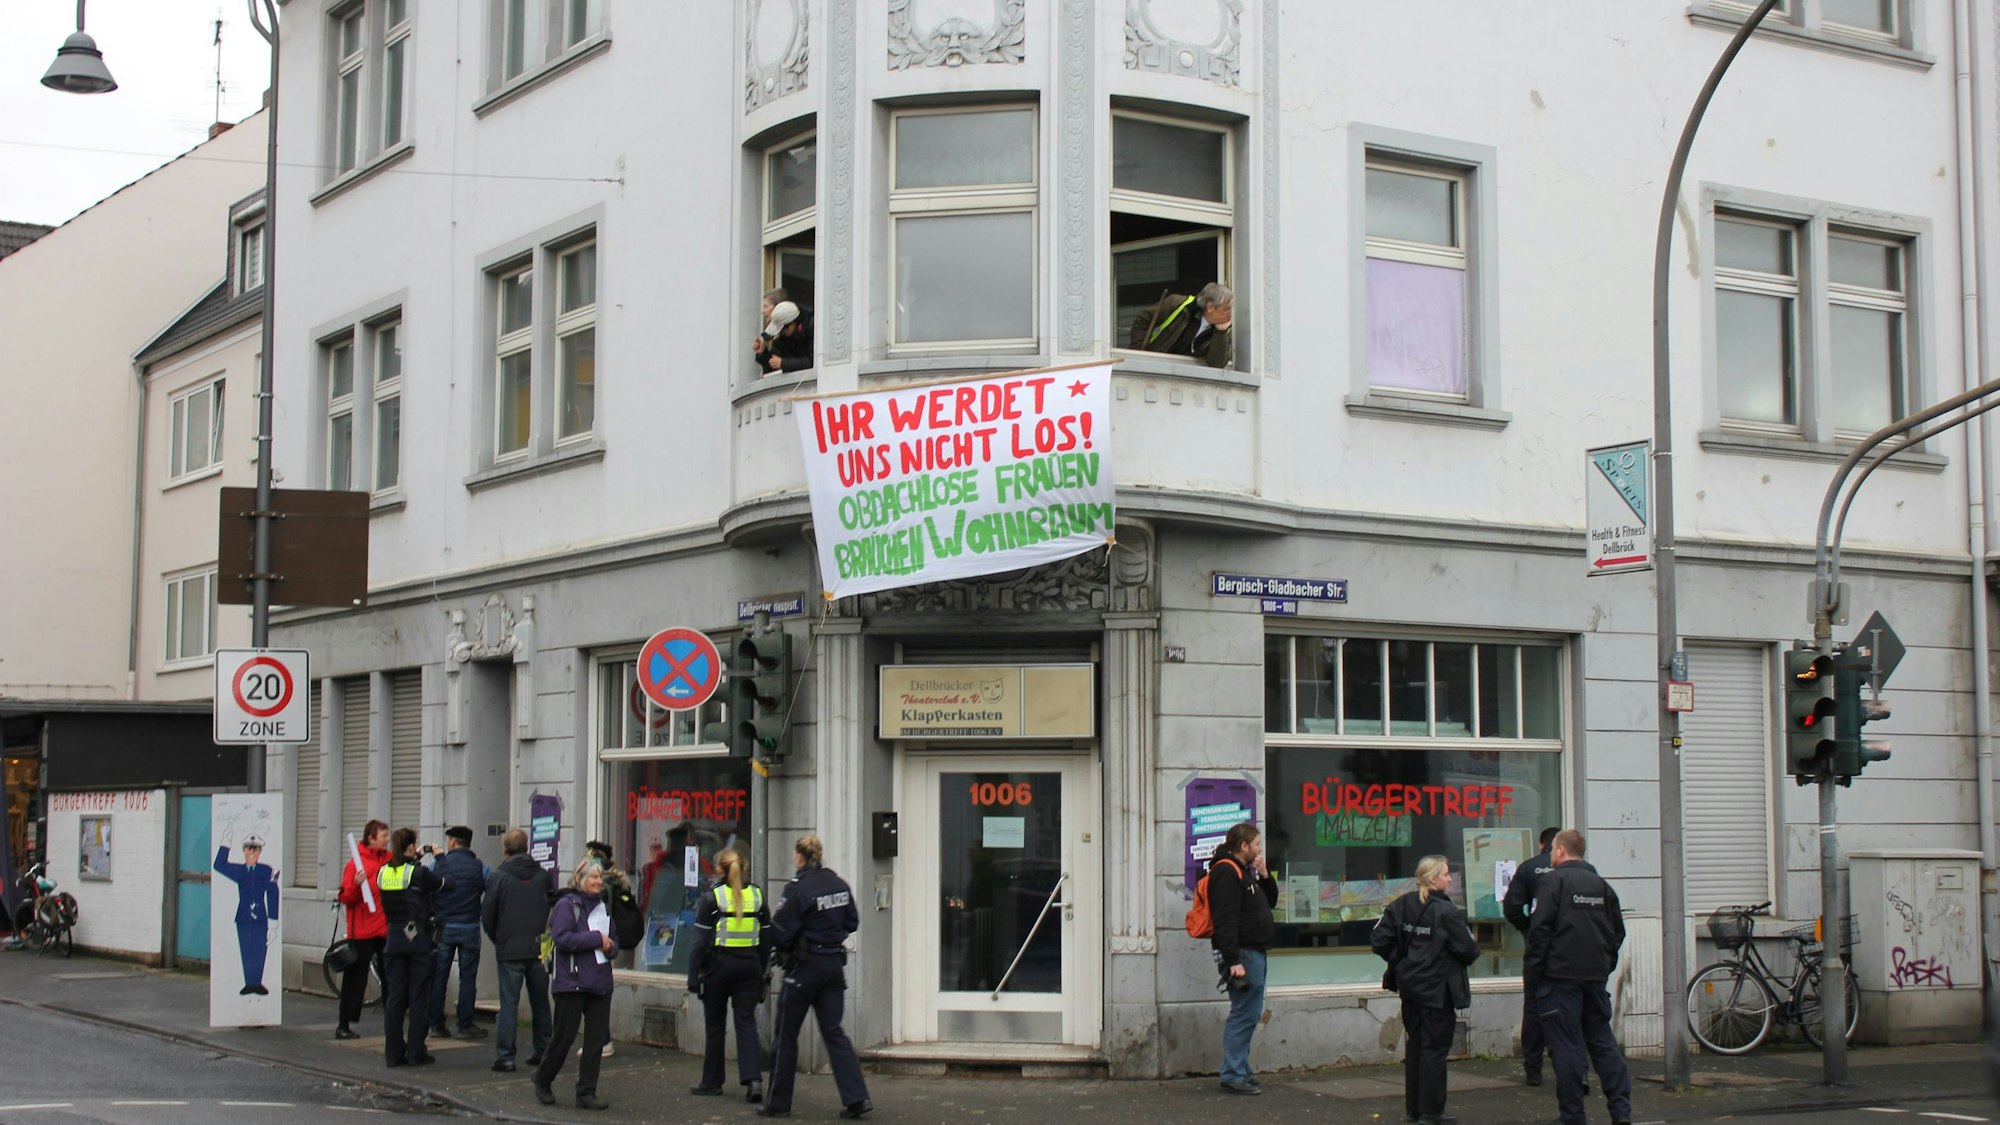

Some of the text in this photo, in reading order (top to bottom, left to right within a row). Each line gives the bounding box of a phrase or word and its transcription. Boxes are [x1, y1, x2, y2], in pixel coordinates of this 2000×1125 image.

[812, 378, 1055, 453] IHR WERDET
[837, 411, 1092, 488] UNS NICHT LOS!
[838, 469, 979, 530] OBDACHLOSE
[924, 502, 1113, 559] WOHNRAUM
[1592, 525, 1646, 541] Health & Fitness
[1602, 541, 1635, 554] Dellbrück
[1218, 576, 1345, 598] Bergisch-Gladbacher Str.
[246, 674, 281, 700] 20
[911, 680, 974, 691] Dellbrücker
[901, 693, 960, 705] Theaterclub
[901, 709, 1003, 725] Klapperkasten
[239, 721, 286, 736] ZONE
[124, 790, 148, 811] 1006
[628, 786, 747, 821] BÜRGERTREFF
[969, 783, 1032, 806] 1006
[1302, 777, 1514, 817] BÜRGERTREFF
[816, 891, 850, 911] POLIZEI
